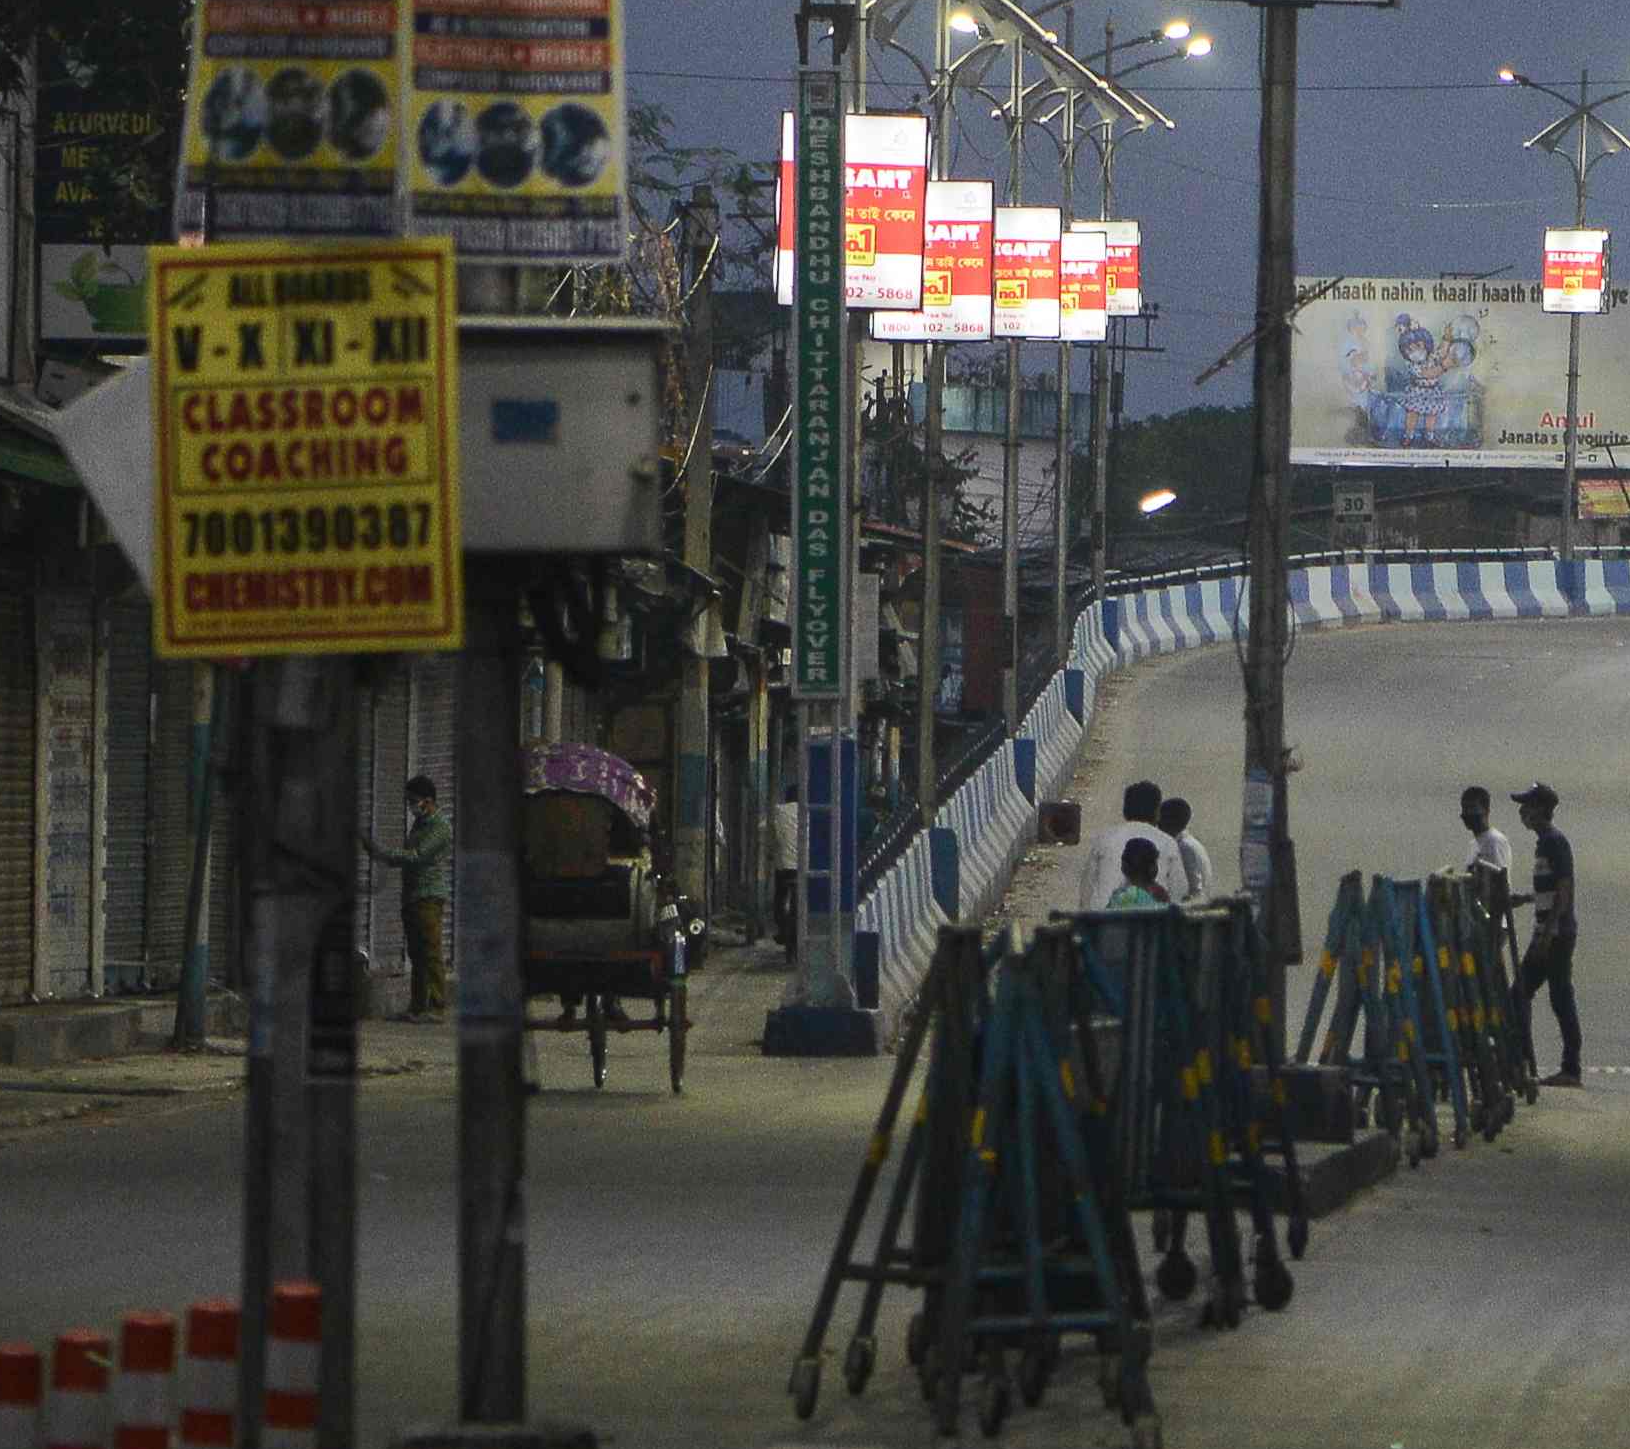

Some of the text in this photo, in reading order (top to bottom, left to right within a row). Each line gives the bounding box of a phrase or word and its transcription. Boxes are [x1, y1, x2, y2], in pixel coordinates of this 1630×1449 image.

[877, 287, 913, 300] 5868
[1332, 282, 1377, 300] haath
[1432, 282, 1478, 302] thaali
[1482, 283, 1527, 303] haath
[239, 321, 264, 370] X
[294, 318, 334, 366] XI
[373, 315, 428, 363] XII
[954, 323, 985, 334] 5868
[182, 386, 425, 433] CLASSROOM
[805, 116, 832, 682] DESHBANDHU CHITTARANJAN DAS FLYOVER
[202, 436, 407, 482] COACHING
[1498, 430, 1558, 445] Janata's
[184, 564, 433, 611] CHEMISTRY.COM
